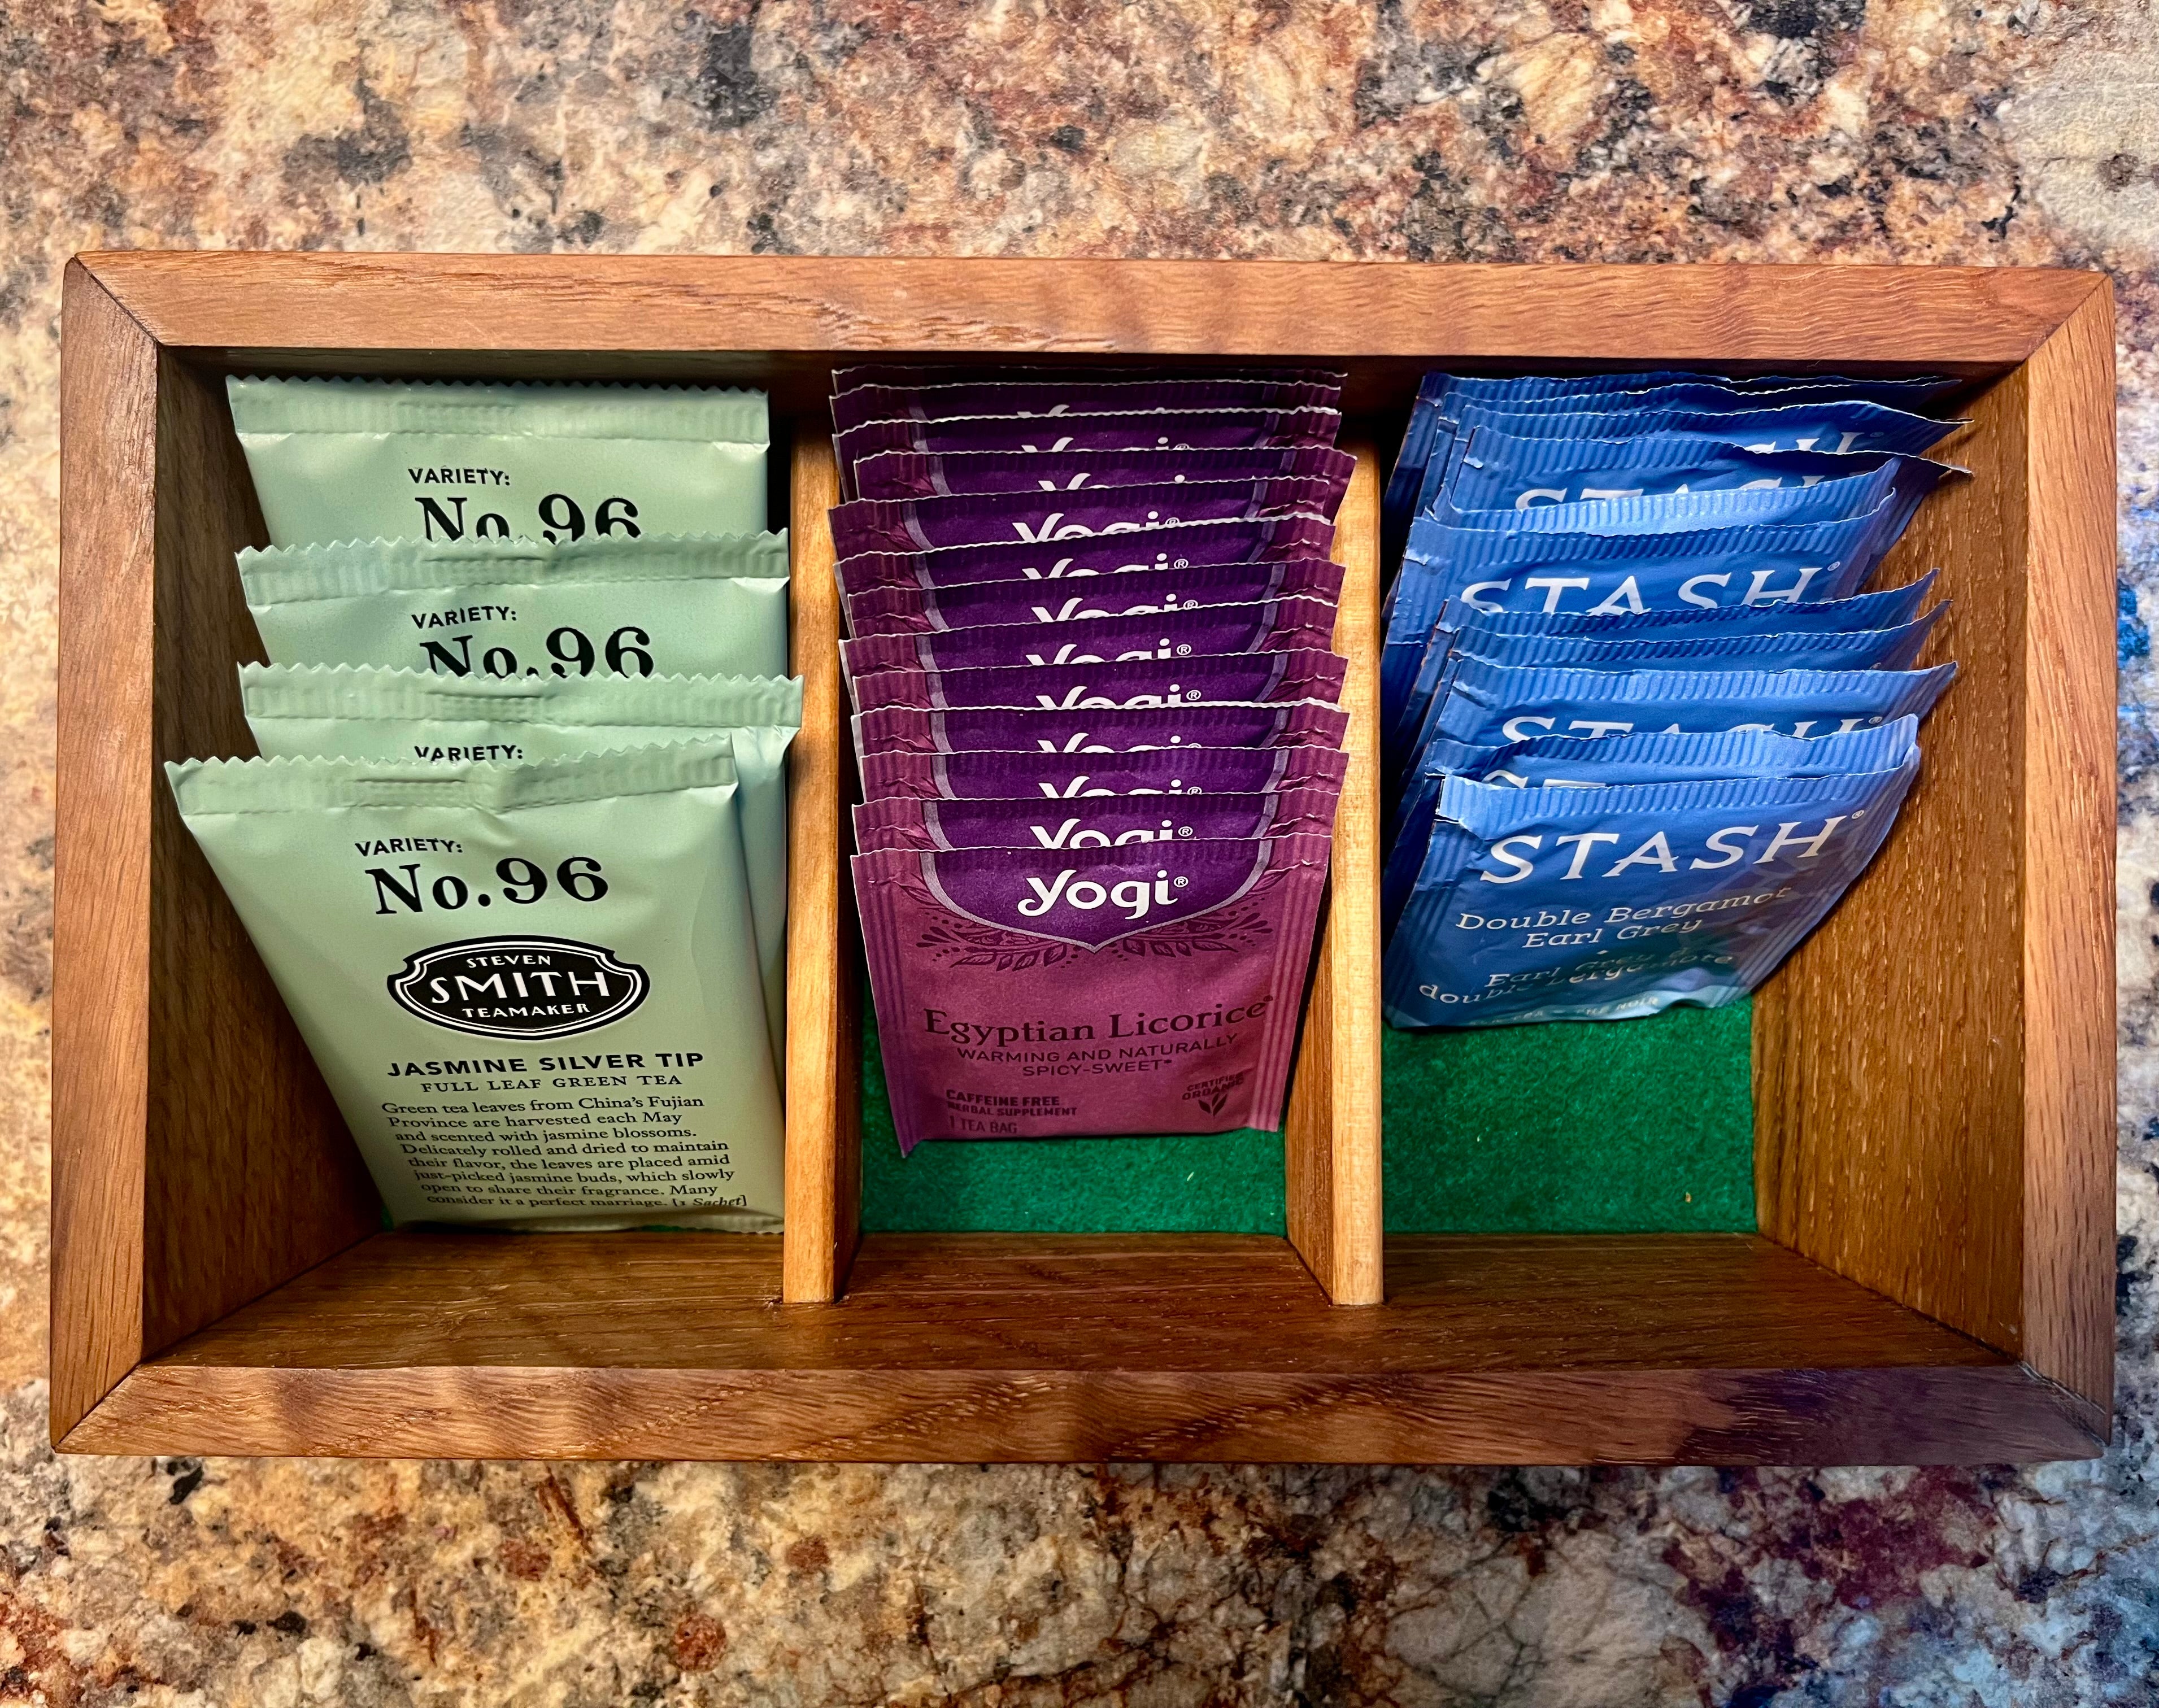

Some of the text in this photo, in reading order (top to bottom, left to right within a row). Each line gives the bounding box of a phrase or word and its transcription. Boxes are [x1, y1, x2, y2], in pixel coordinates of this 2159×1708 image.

[408, 468, 510, 486] VARIETY:
[415, 494, 641, 545] No96
[411, 605, 517, 629] VARIETY:
[414, 745, 523, 762] VARIETY:
[355, 837, 463, 857] VARIETY:
[364, 856, 608, 915] No.96
[1456, 887, 1791, 930] Double Bergamot
[1522, 919, 1703, 948] Earl Grey
[467, 955, 551, 969] STEVEN
[1485, 967, 1561, 987] Earl
[429, 971, 611, 1004] SMITH
[462, 1003, 590, 1018] TEAMAKER
[923, 1008, 1096, 1048] Egyptian
[957, 1032, 1238, 1062] WARMING AND NATURALLY
[388, 1053, 703, 1077] JASMINE SILVER TIP
[421, 1075, 682, 1092] FULL LEAF GREEN TEA
[381, 1103, 438, 1113] Green
[442, 1104, 469, 1113] tea
[472, 1101, 526, 1113] leaves
[530, 1100, 574, 1111] from
[647, 1096, 705, 1110] Fujian
[946, 1089, 1060, 1106] CAFFEINE FREE
[387, 1112, 682, 1128] Province are harvested each May
[996, 1107, 1077, 1117] SUPPLEMENT
[960, 1118, 986, 1132] TEA
[990, 1121, 1017, 1134] BAG
[395, 1128, 697, 1143] and scented with jasmine blossoms.
[400, 1140, 730, 1158] Delicately rolled and dried to maintain
[407, 1154, 730, 1171] their flavor, the leaves are placed amid
[413, 1168, 735, 1184] just-picked jasmine buds, which slowly
[421, 1184, 461, 1193] open
[487, 1185, 532, 1195] share
[536, 1186, 576, 1196] their
[581, 1185, 665, 1197] fragrance.
[669, 1185, 719, 1196] Many
[426, 1196, 495, 1205] consider
[529, 1197, 585, 1208] perfect
[591, 1198, 667, 1208] marriage.
[693, 1195, 747, 1208] Sachet]
